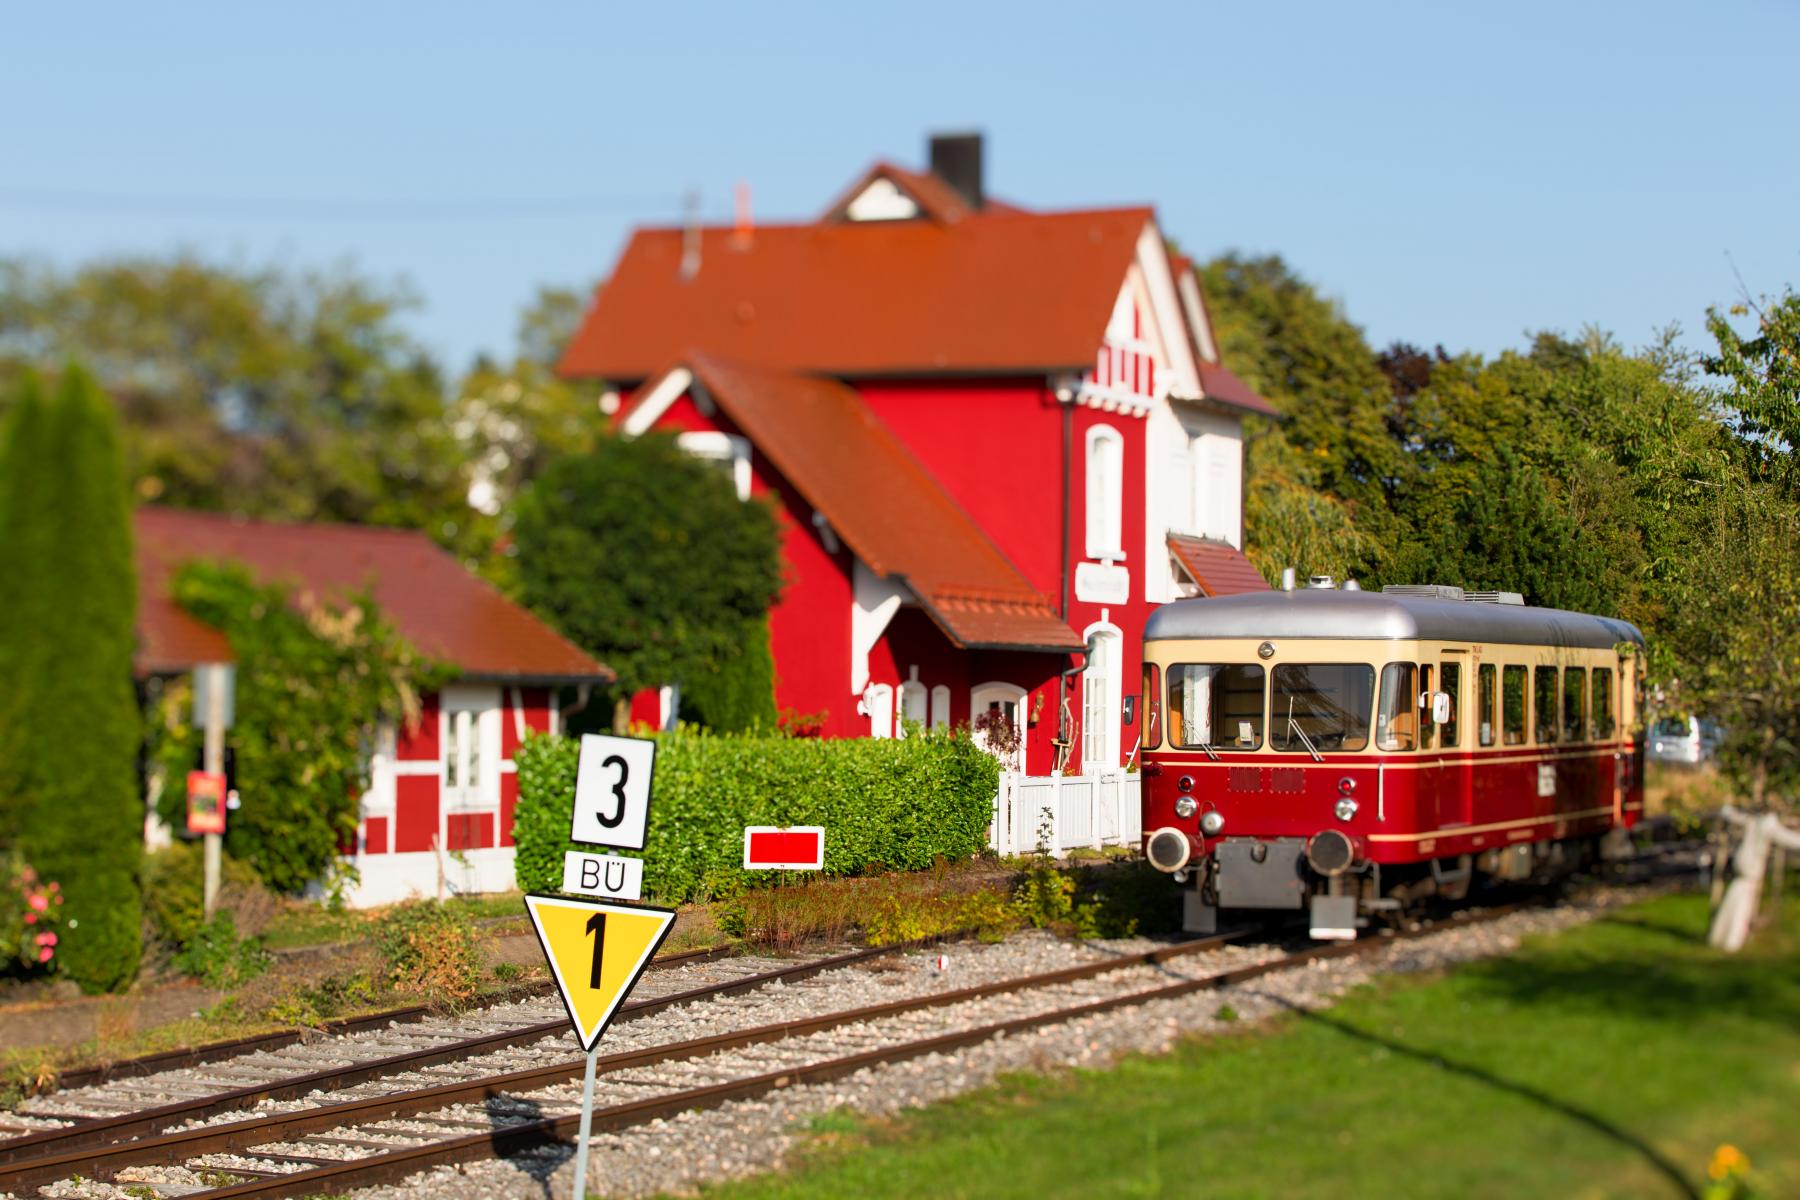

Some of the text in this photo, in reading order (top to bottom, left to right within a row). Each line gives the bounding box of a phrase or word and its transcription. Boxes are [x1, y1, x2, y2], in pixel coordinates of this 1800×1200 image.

[596, 755, 629, 828] 3
[581, 858, 626, 893] BÜ
[585, 912, 607, 990] 1
